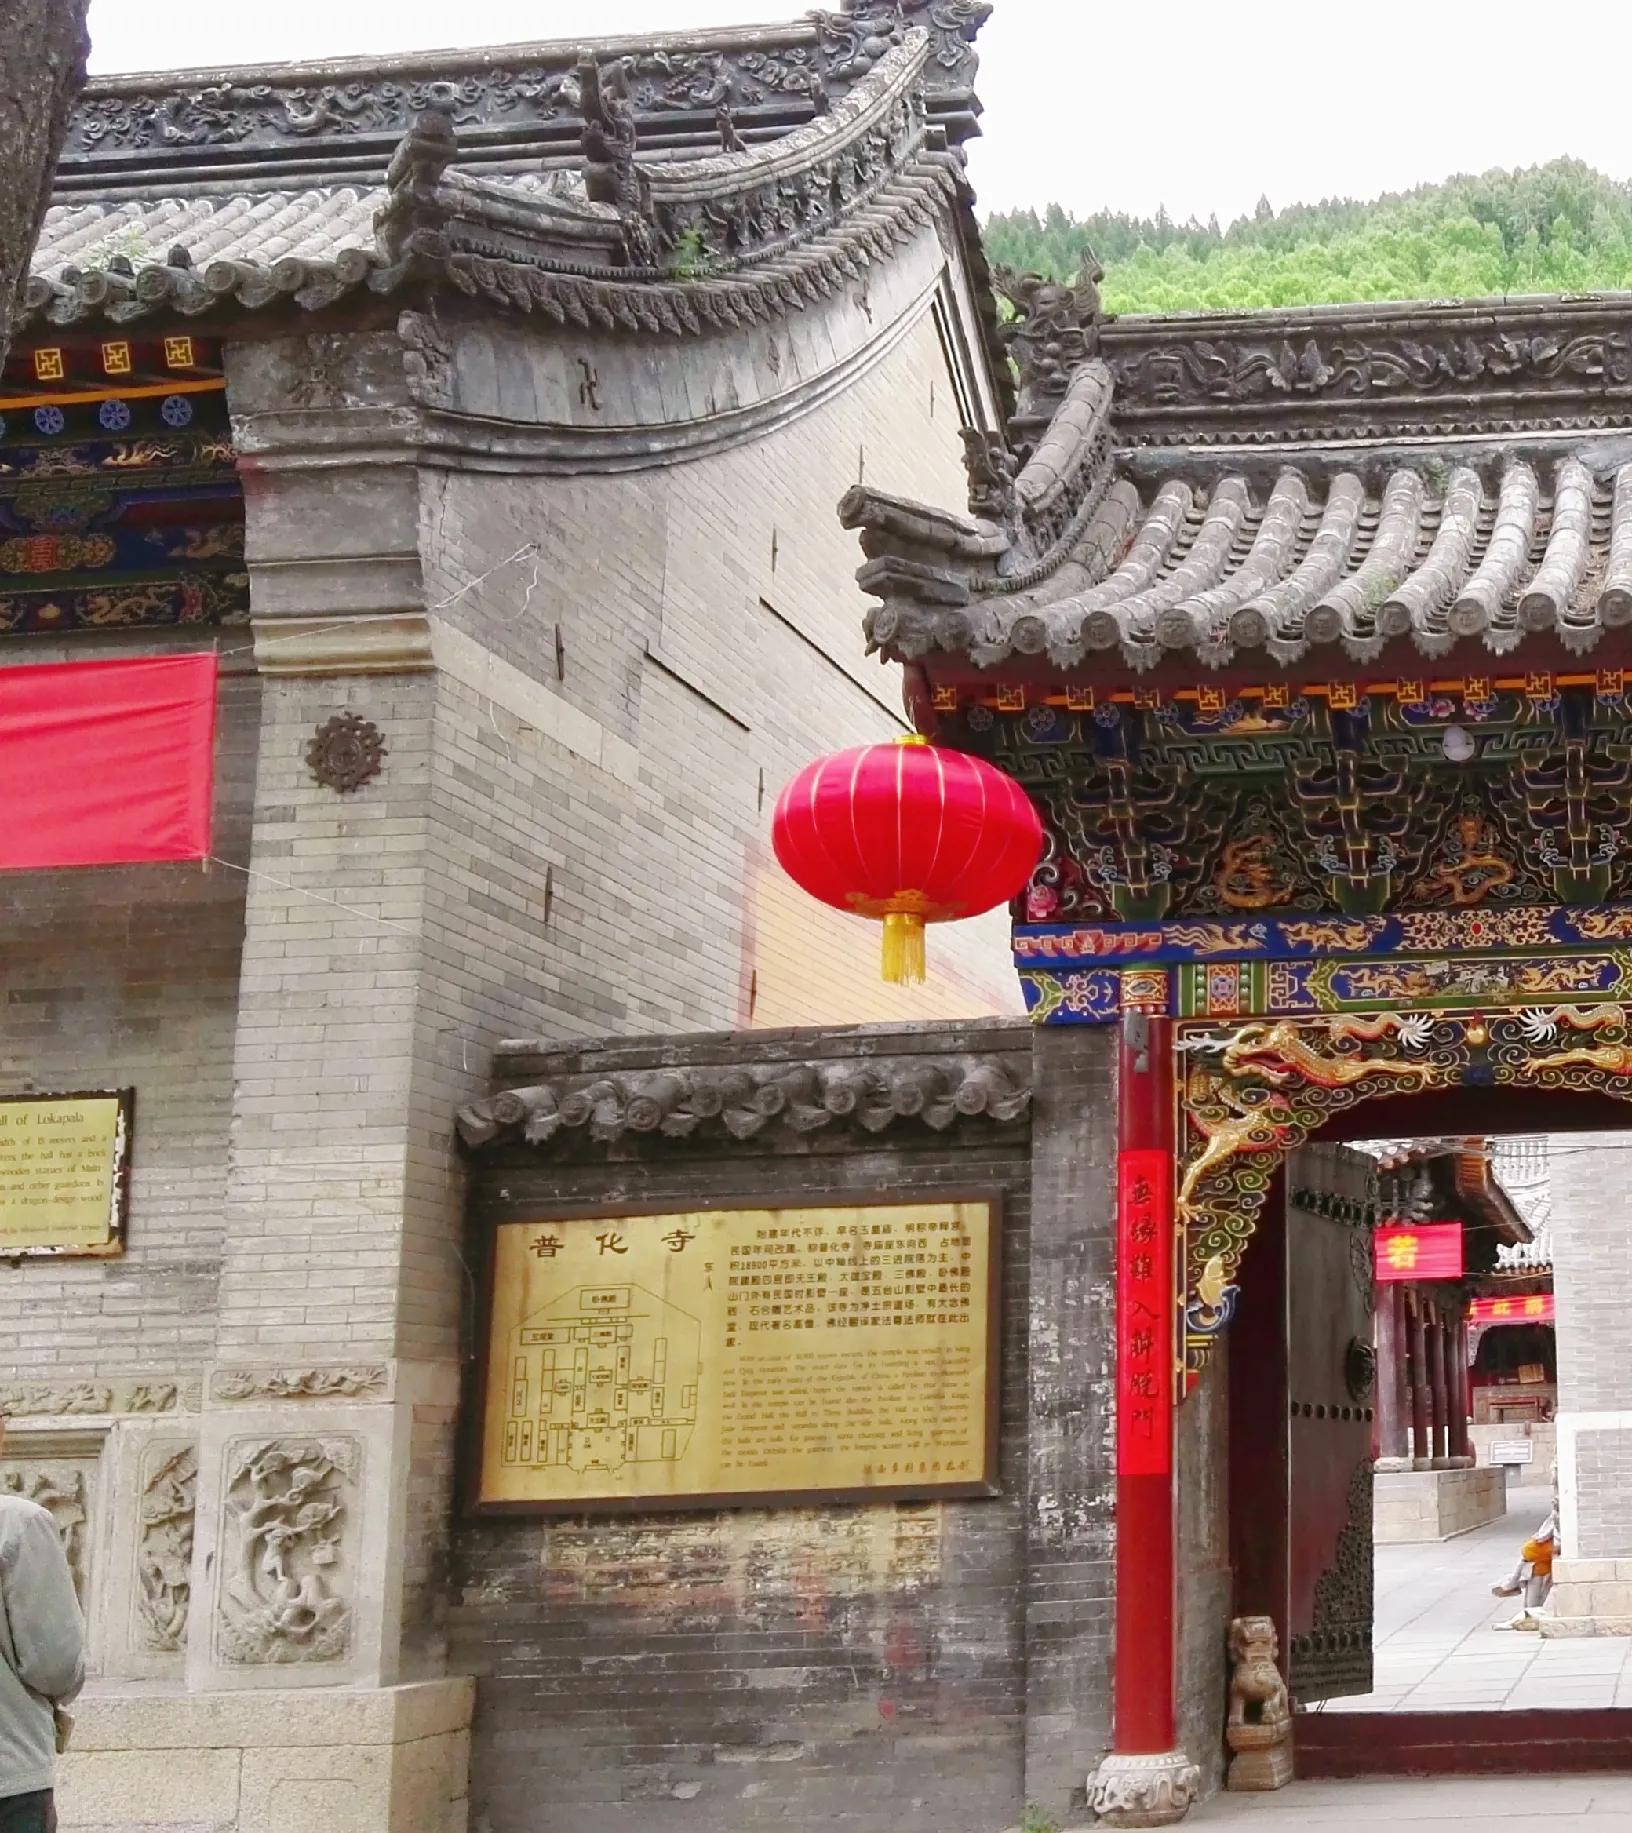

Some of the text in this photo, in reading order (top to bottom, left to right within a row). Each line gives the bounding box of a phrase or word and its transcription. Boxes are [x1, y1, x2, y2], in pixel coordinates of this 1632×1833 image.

[15, 1113, 28, 1125] of
[37, 1111, 84, 1126] Lokapala
[529, 1229, 696, 1258] 普化寺
